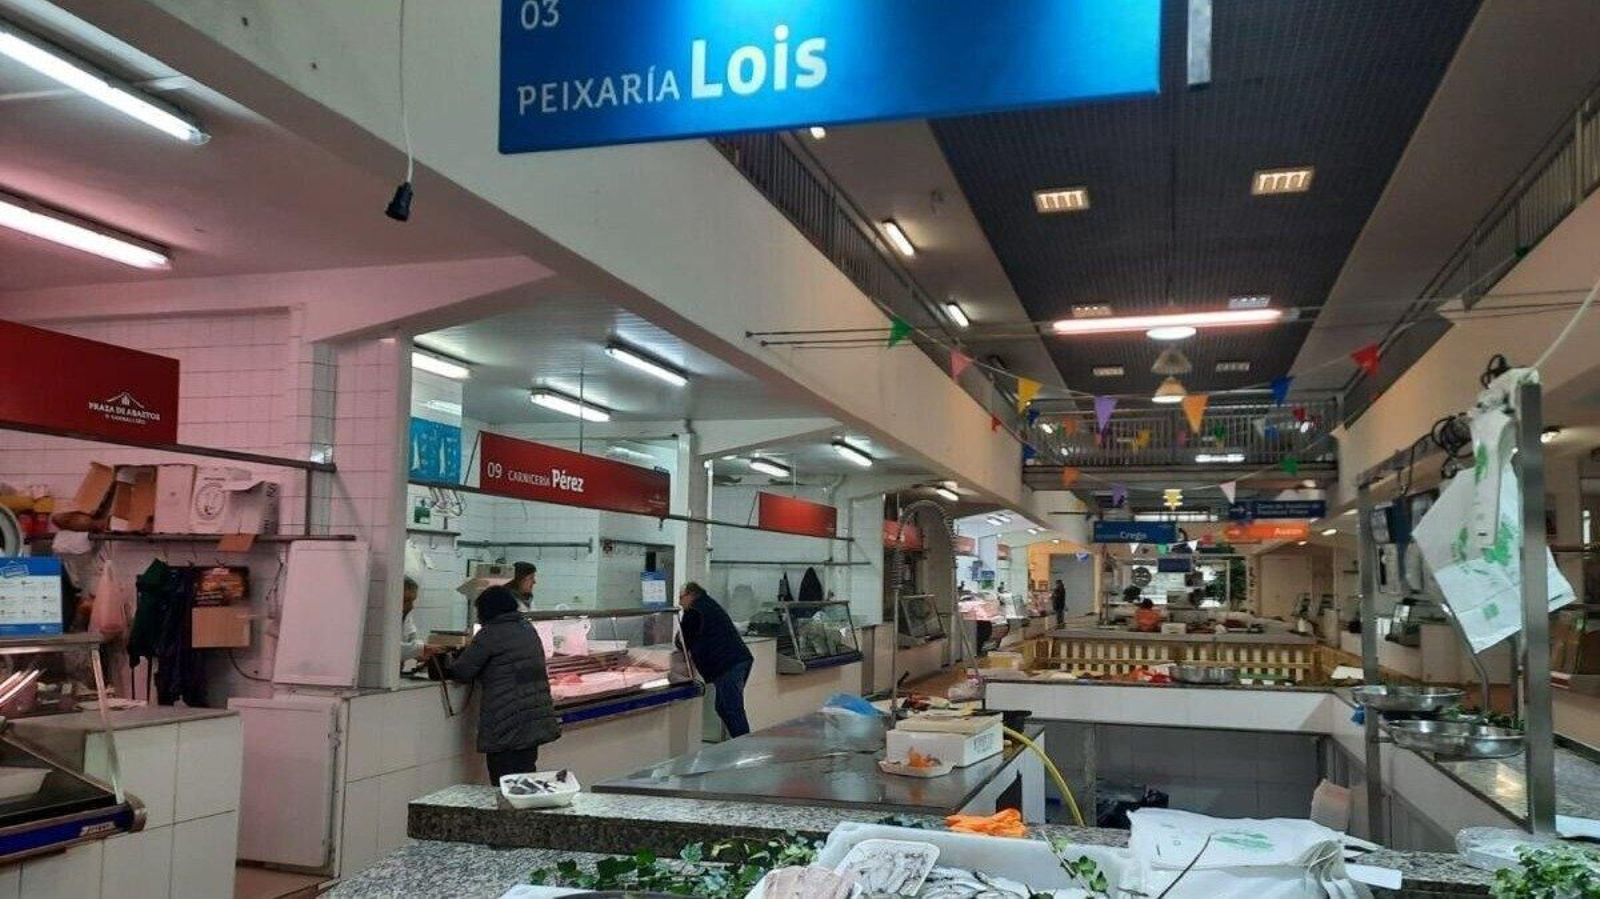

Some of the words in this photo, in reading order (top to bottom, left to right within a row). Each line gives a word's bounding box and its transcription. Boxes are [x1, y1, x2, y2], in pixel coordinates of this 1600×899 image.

[520, 0, 561, 30] 03
[518, 66, 679, 116] PEIXARÍA
[691, 24, 829, 100] Lois
[487, 462, 502, 478] 09
[551, 468, 584, 493] Pérez
